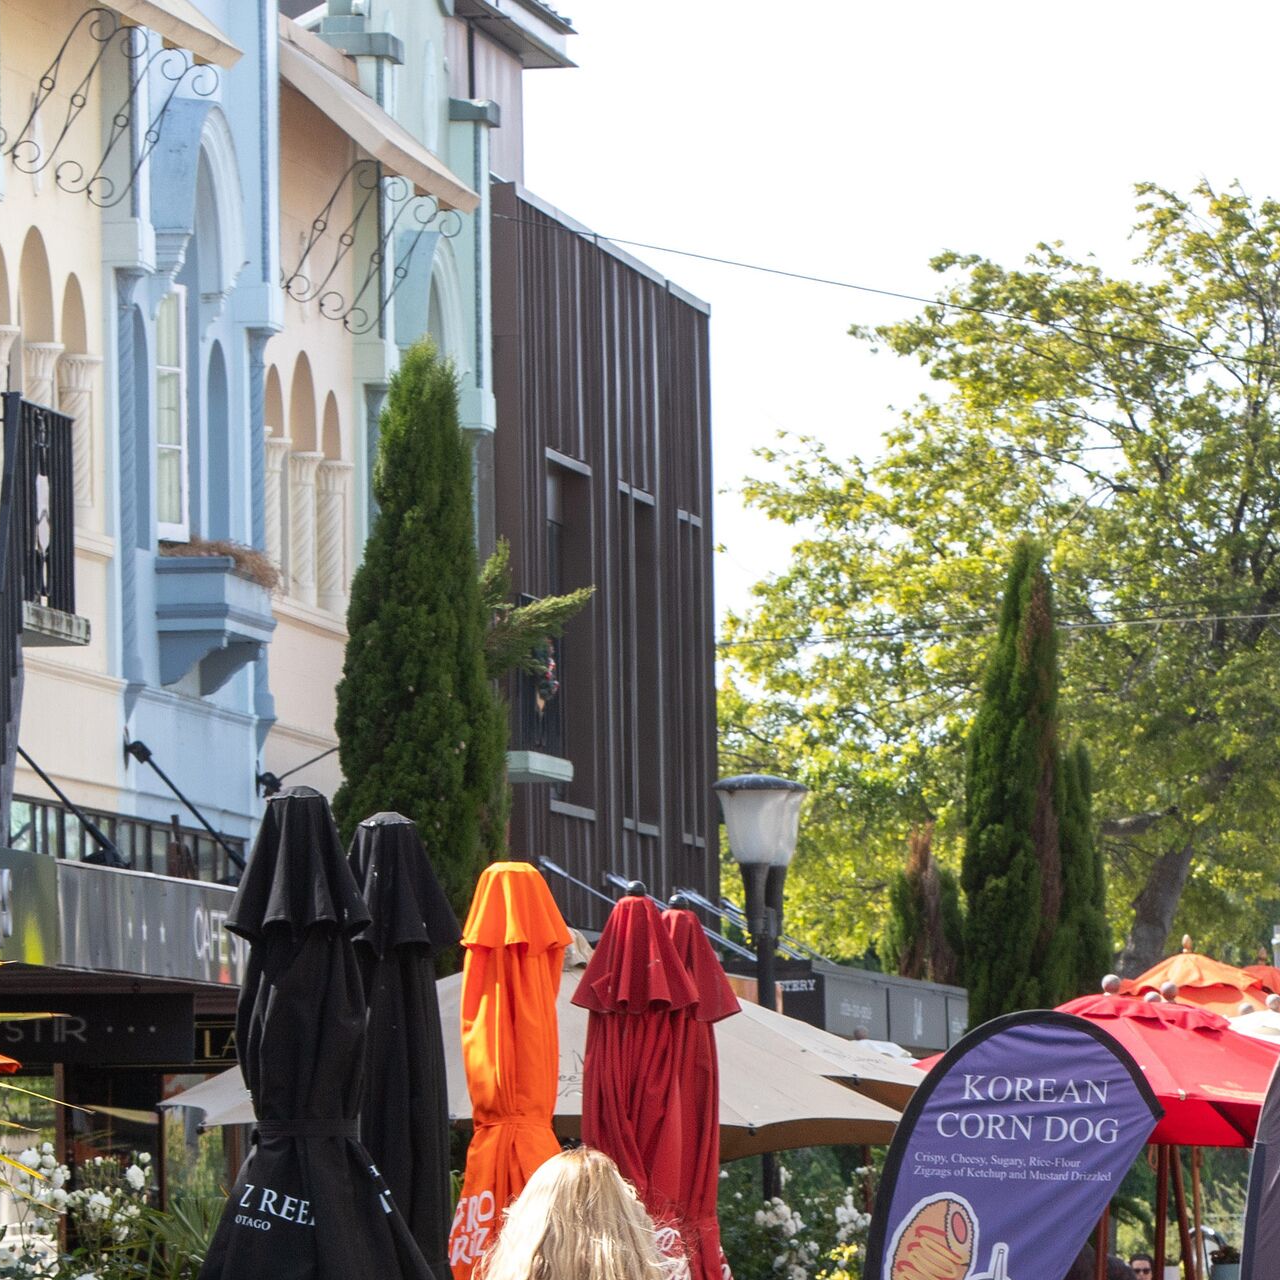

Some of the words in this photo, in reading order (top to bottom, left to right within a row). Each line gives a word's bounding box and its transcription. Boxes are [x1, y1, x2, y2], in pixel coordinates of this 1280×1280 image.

[6, 1015, 88, 1043] STIR
[961, 1074, 1110, 1105] KOREAN
[936, 1111, 1035, 1141] CORN
[1043, 1115, 1120, 1144] DOG
[913, 1165, 952, 1177] Zigzags
[954, 1167, 965, 1176] of
[966, 1168, 1007, 1181] Ketchup
[1009, 1170, 1027, 1179] and
[1029, 1171, 1069, 1181] Mustard
[1071, 1172, 1112, 1182] Drizzled
[914, 1151, 949, 1164] Crispy,
[951, 1152, 988, 1166] Cheesy,
[990, 1154, 1026, 1168] Sugary,
[1029, 1156, 1081, 1168] Rice-Flour
[257, 1187, 317, 1226] REE
[234, 1214, 271, 1232] OTAGO
